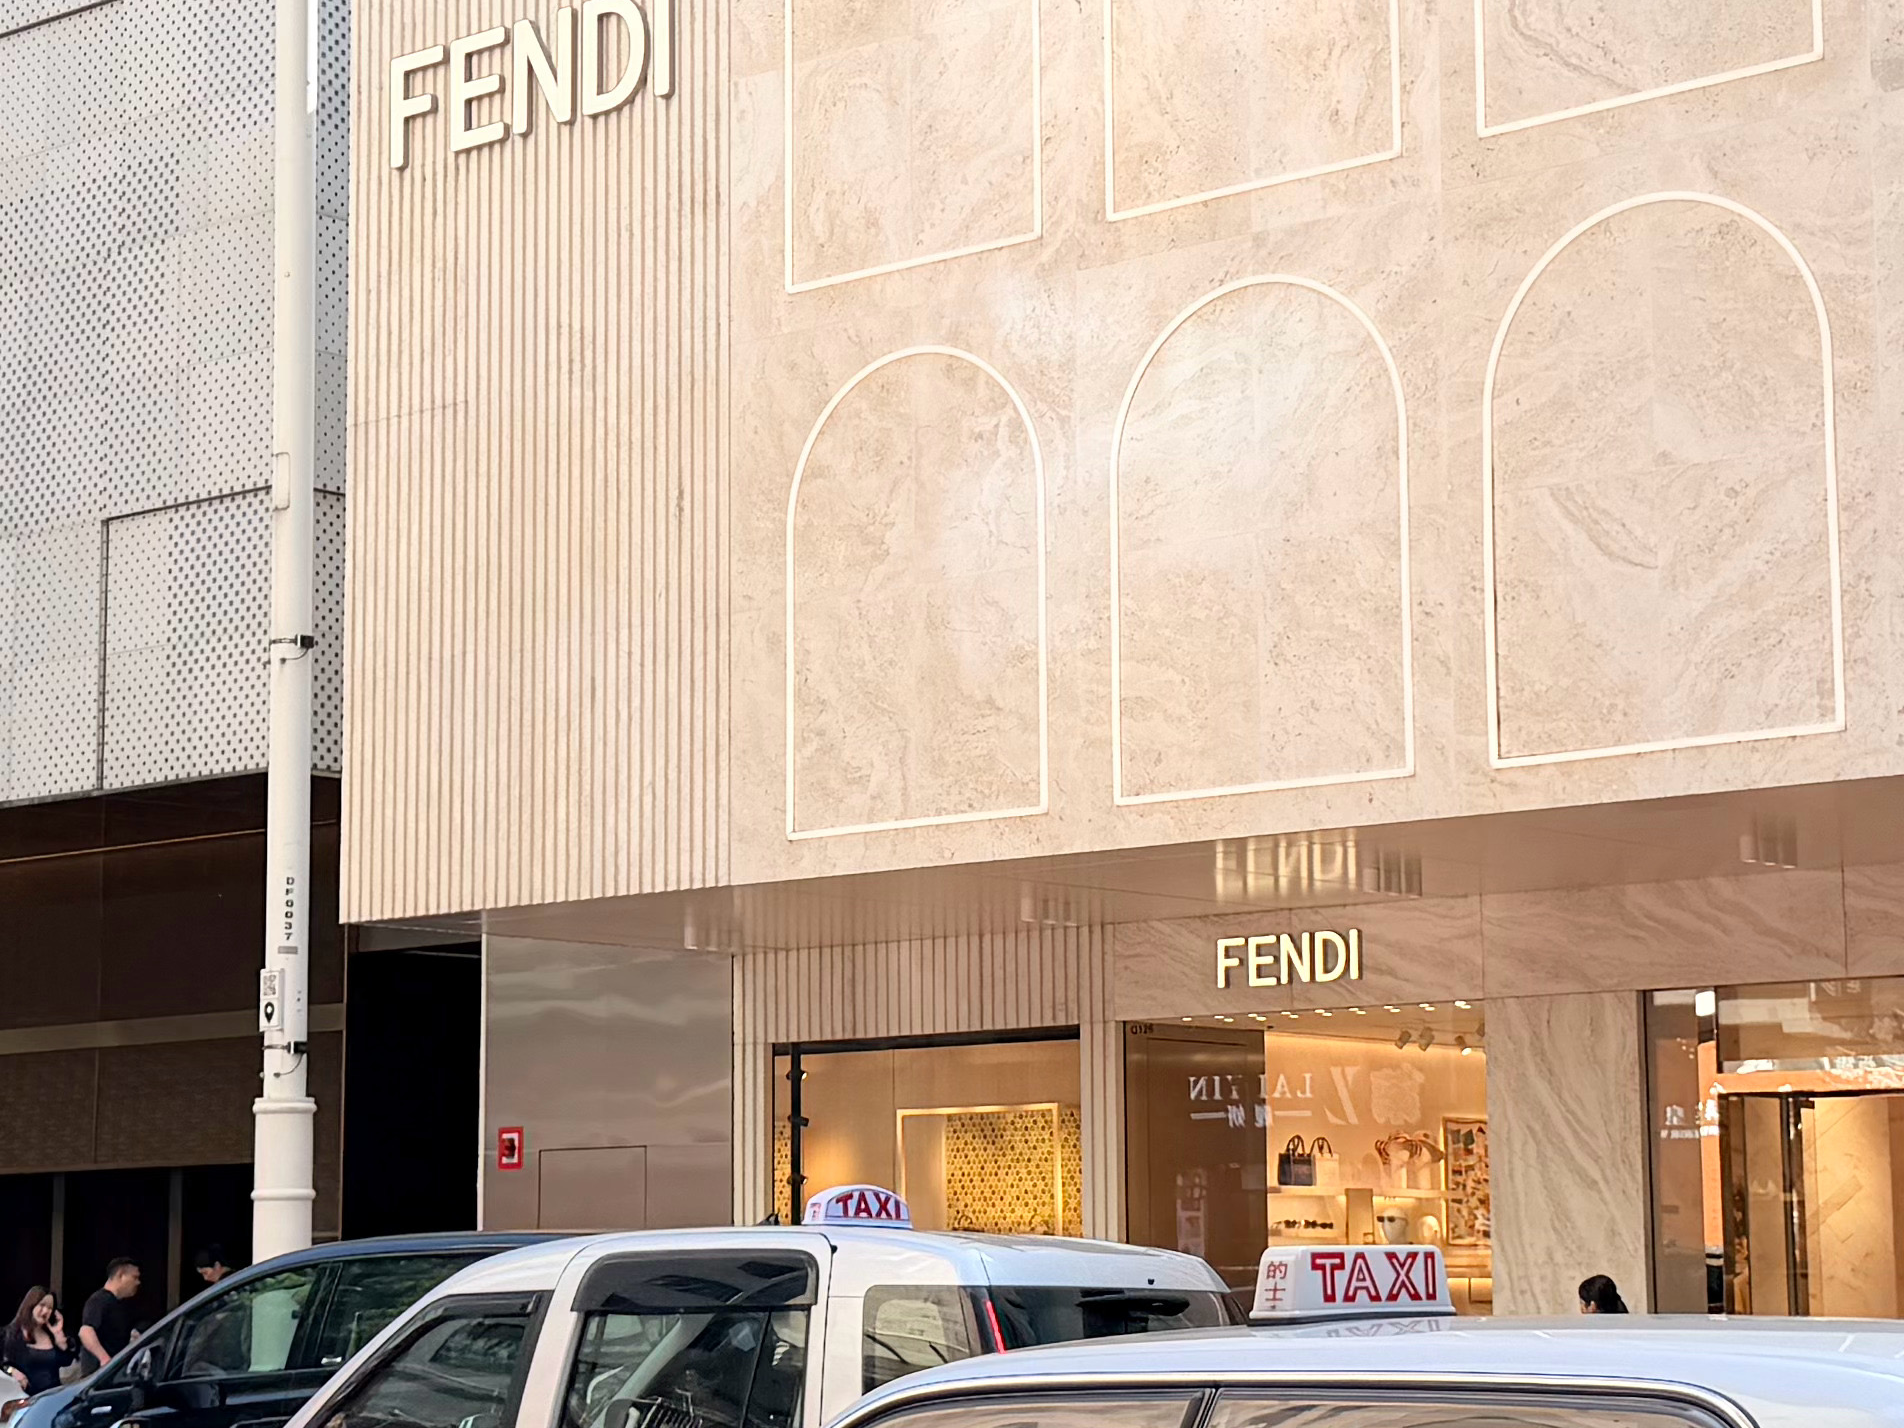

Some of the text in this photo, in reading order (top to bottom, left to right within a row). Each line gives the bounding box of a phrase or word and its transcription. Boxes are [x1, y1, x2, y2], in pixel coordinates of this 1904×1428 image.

[1217, 928, 1363, 989] FENDI
[835, 1191, 901, 1220] TAXI
[1264, 1260, 1288, 1302] 的士
[1310, 1251, 1437, 1303] TAXI
